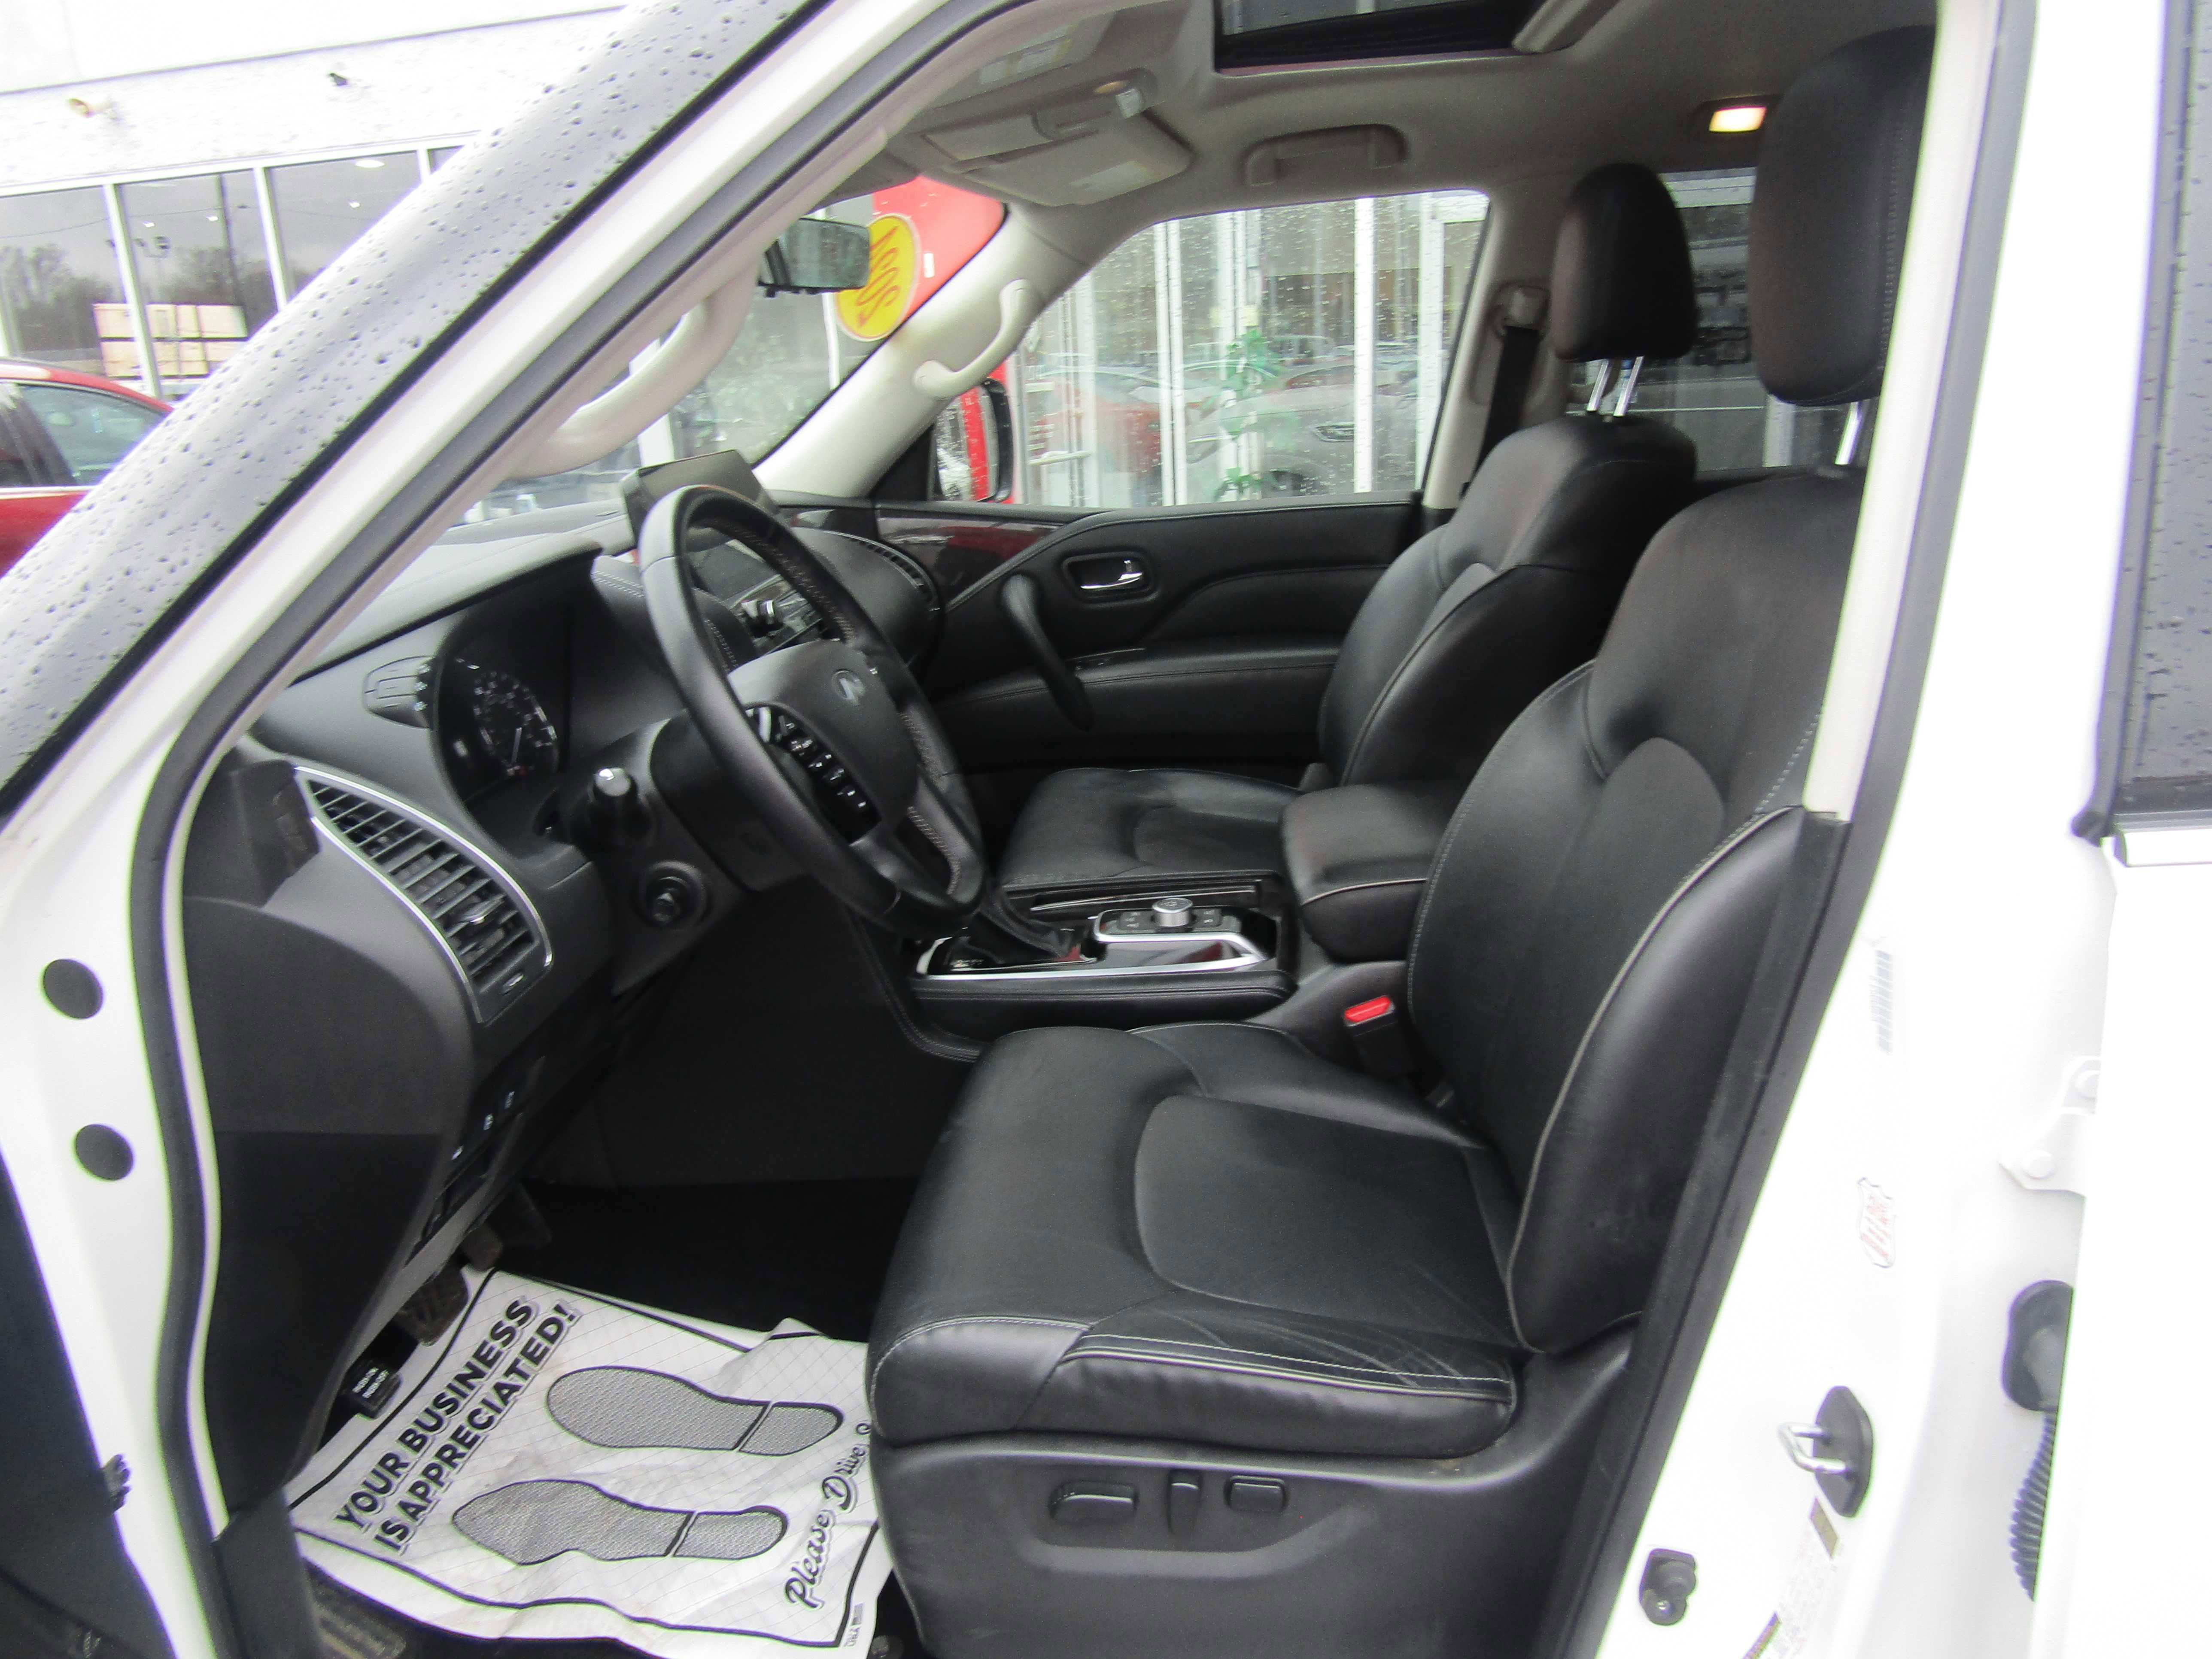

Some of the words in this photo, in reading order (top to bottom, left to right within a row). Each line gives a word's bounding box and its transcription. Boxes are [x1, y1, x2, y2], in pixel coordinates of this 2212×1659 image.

[334, 1451, 411, 1530] YOUR
[397, 1298, 534, 1454] BUSINESS
[374, 1519, 410, 1552] IS
[397, 1303, 578, 1522] APPRECIATED!
[785, 1513, 829, 1608] Please
[822, 1446, 866, 1510] Drive
